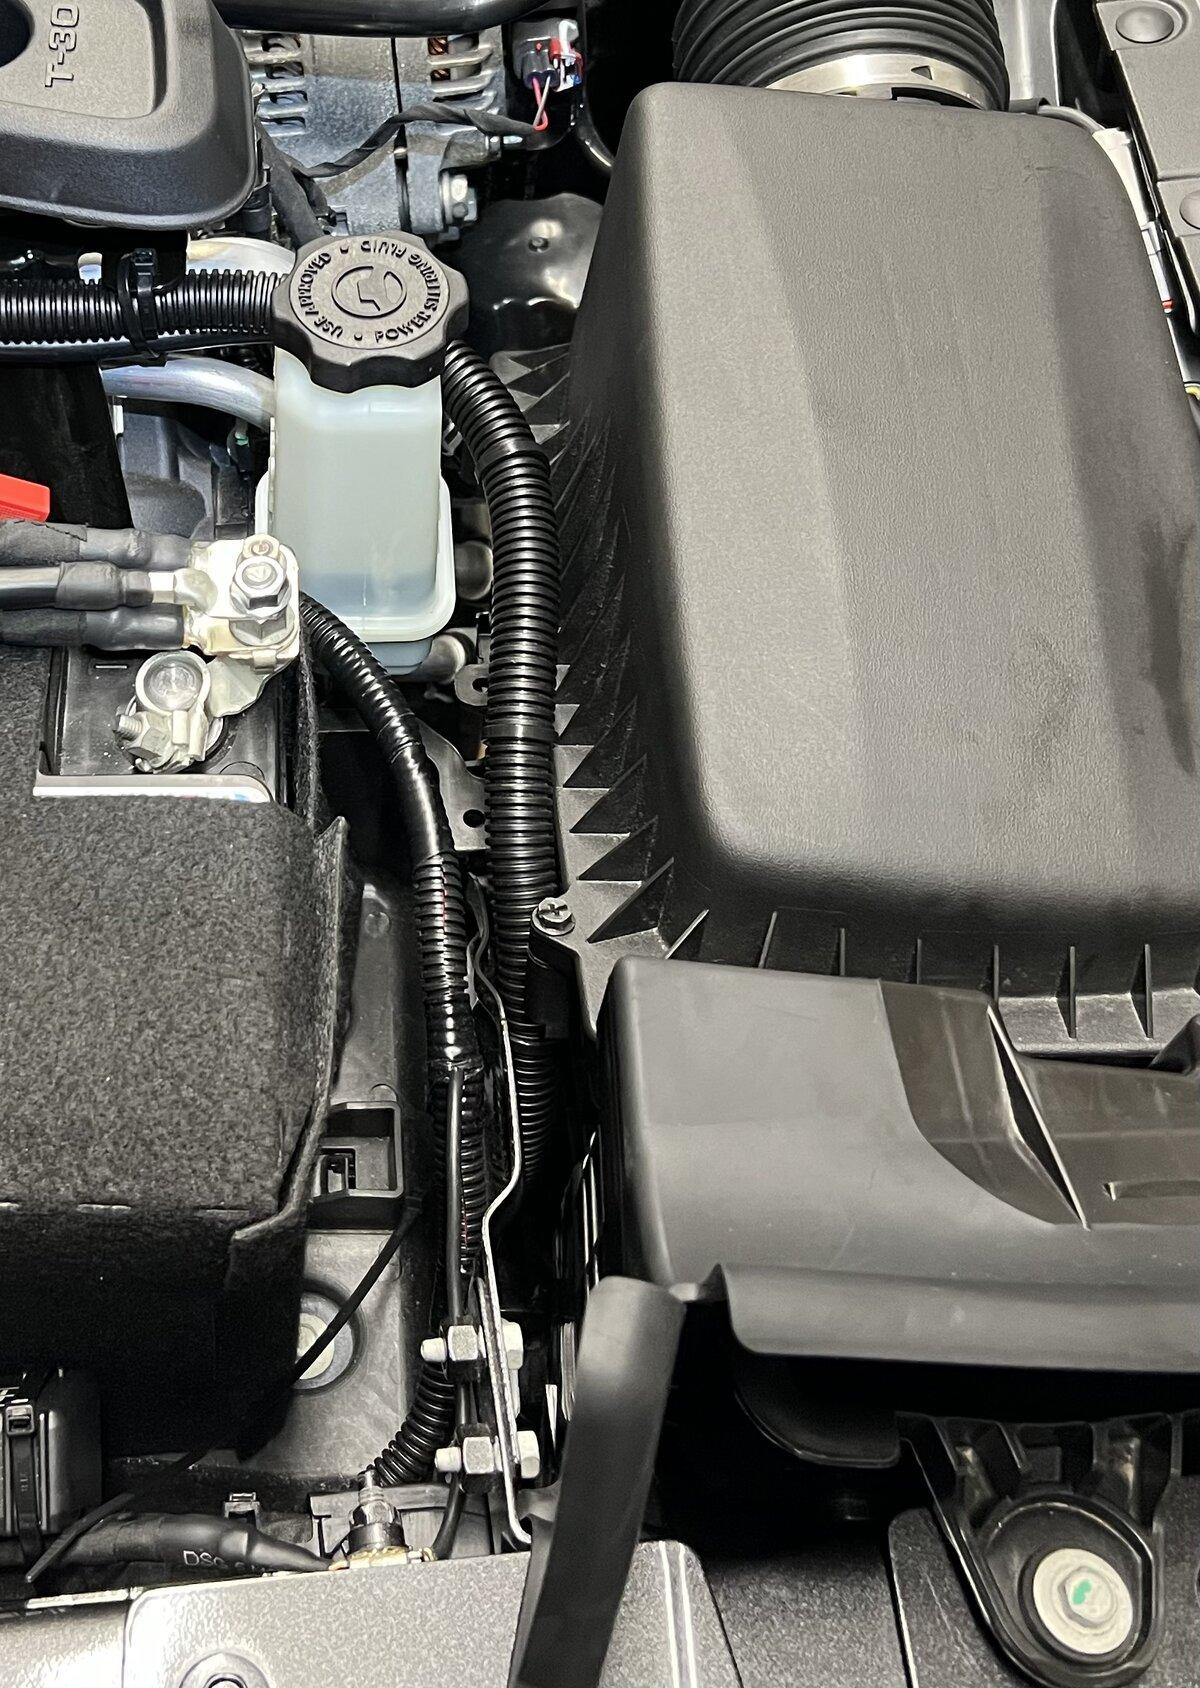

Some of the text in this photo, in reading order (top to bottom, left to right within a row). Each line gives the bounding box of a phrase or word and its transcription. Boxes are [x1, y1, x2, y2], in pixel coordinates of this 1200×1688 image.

[45, 3, 80, 87] T-30
[298, 251, 344, 339] USE APPROVED
[360, 240, 441, 343] POWER STEERING FLUID
